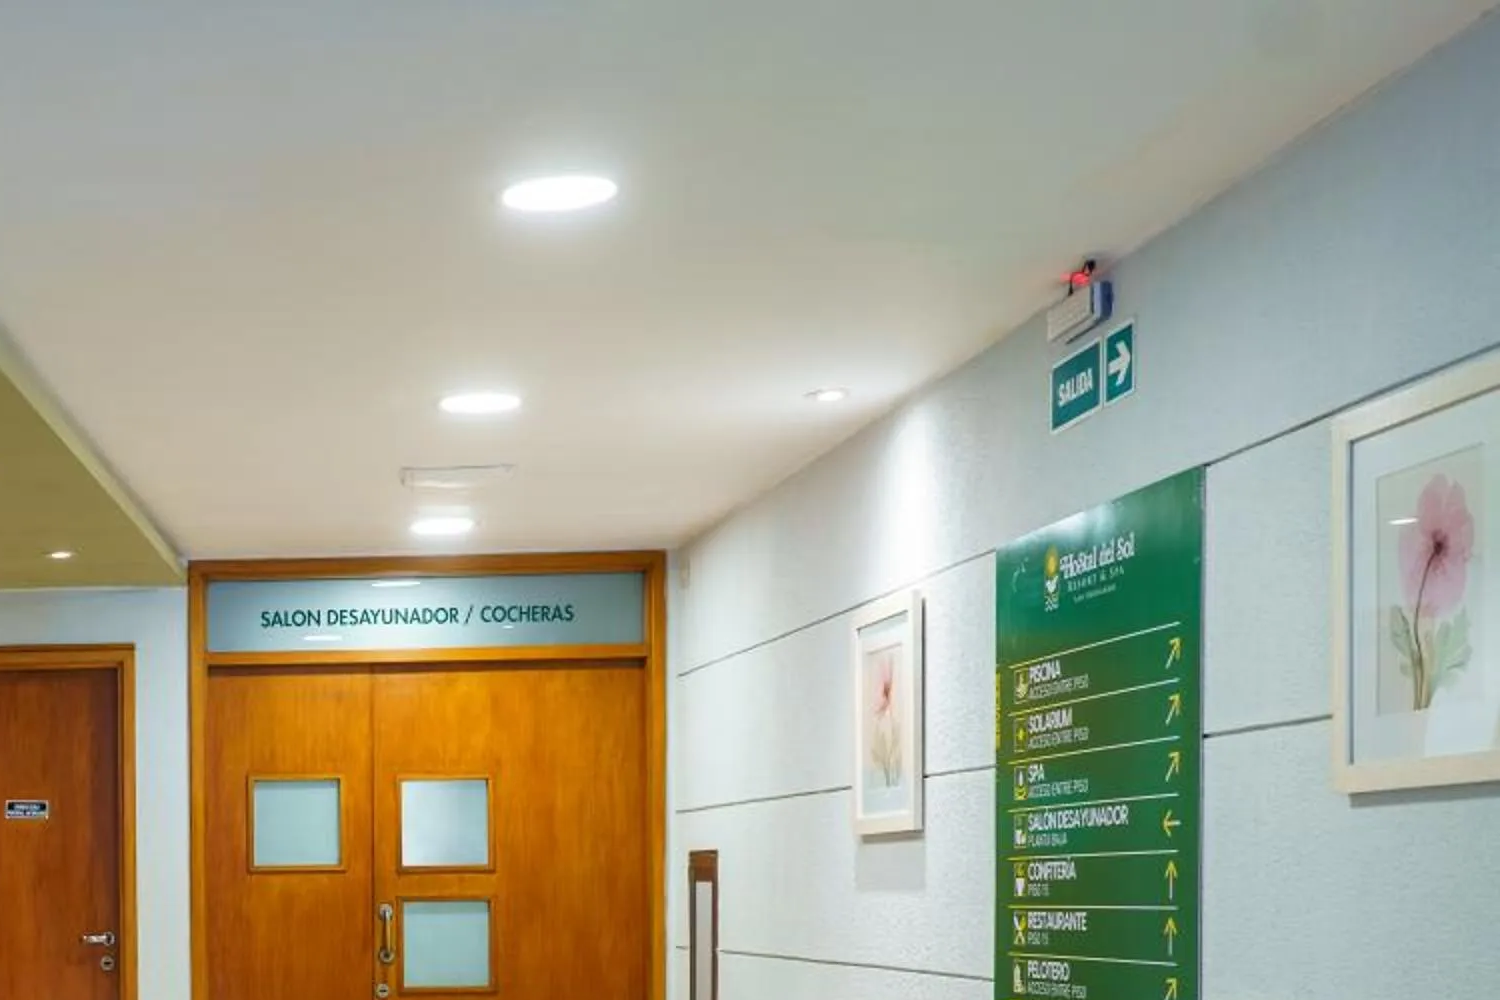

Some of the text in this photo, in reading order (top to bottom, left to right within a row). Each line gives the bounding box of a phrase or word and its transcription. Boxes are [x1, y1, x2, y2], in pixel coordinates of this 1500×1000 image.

[1058, 368, 1093, 407] SALIDA
[1060, 532, 1136, 579] Hostal del Sol
[261, 603, 575, 628] SALON DESAYUNADOR / COCHERAS
[1028, 660, 1061, 683] PISCINA
[1028, 707, 1073, 733] SOLARIUM
[1028, 764, 1045, 783] SPA
[1059, 804, 1129, 830] DESAYUNADOR
[1028, 911, 1088, 931] RESTAURANTE
[1028, 960, 1070, 981] PELOTERO
